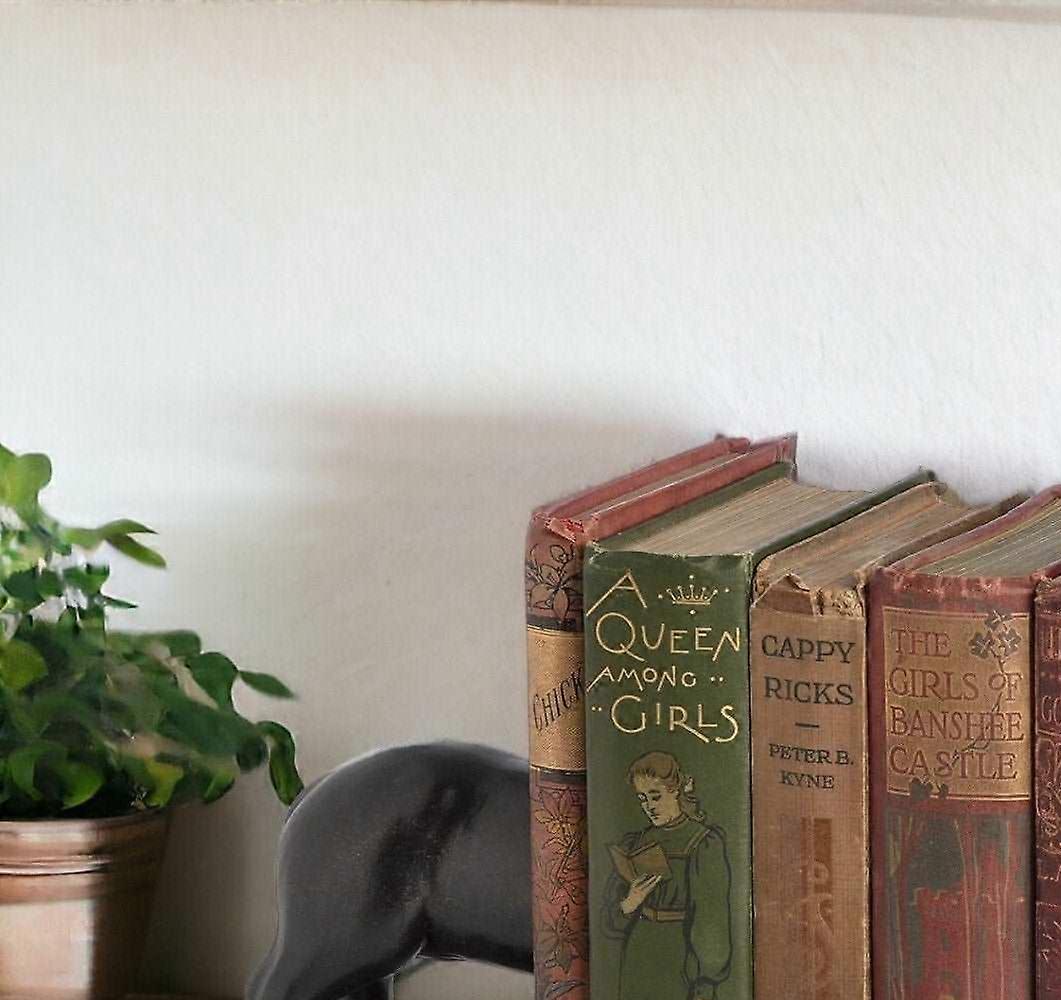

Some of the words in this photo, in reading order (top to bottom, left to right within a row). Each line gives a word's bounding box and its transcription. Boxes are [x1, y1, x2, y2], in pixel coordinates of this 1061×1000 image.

[586, 568, 648, 616] A
[596, 612, 741, 662] QUEEN
[761, 634, 856, 664] CAPPY
[890, 627, 952, 658] THE
[586, 665, 697, 693] AMONG
[763, 675, 854, 706] RICKS
[888, 666, 979, 701] GIRLS
[987, 672, 1024, 702] OF
[611, 695, 739, 743] GIRLS
[889, 704, 1025, 742] BANSHEE
[769, 743, 832, 765] PETER
[835, 750, 854, 766] B.
[888, 744, 1019, 781] CASTLE
[779, 769, 835, 790] KYNE
